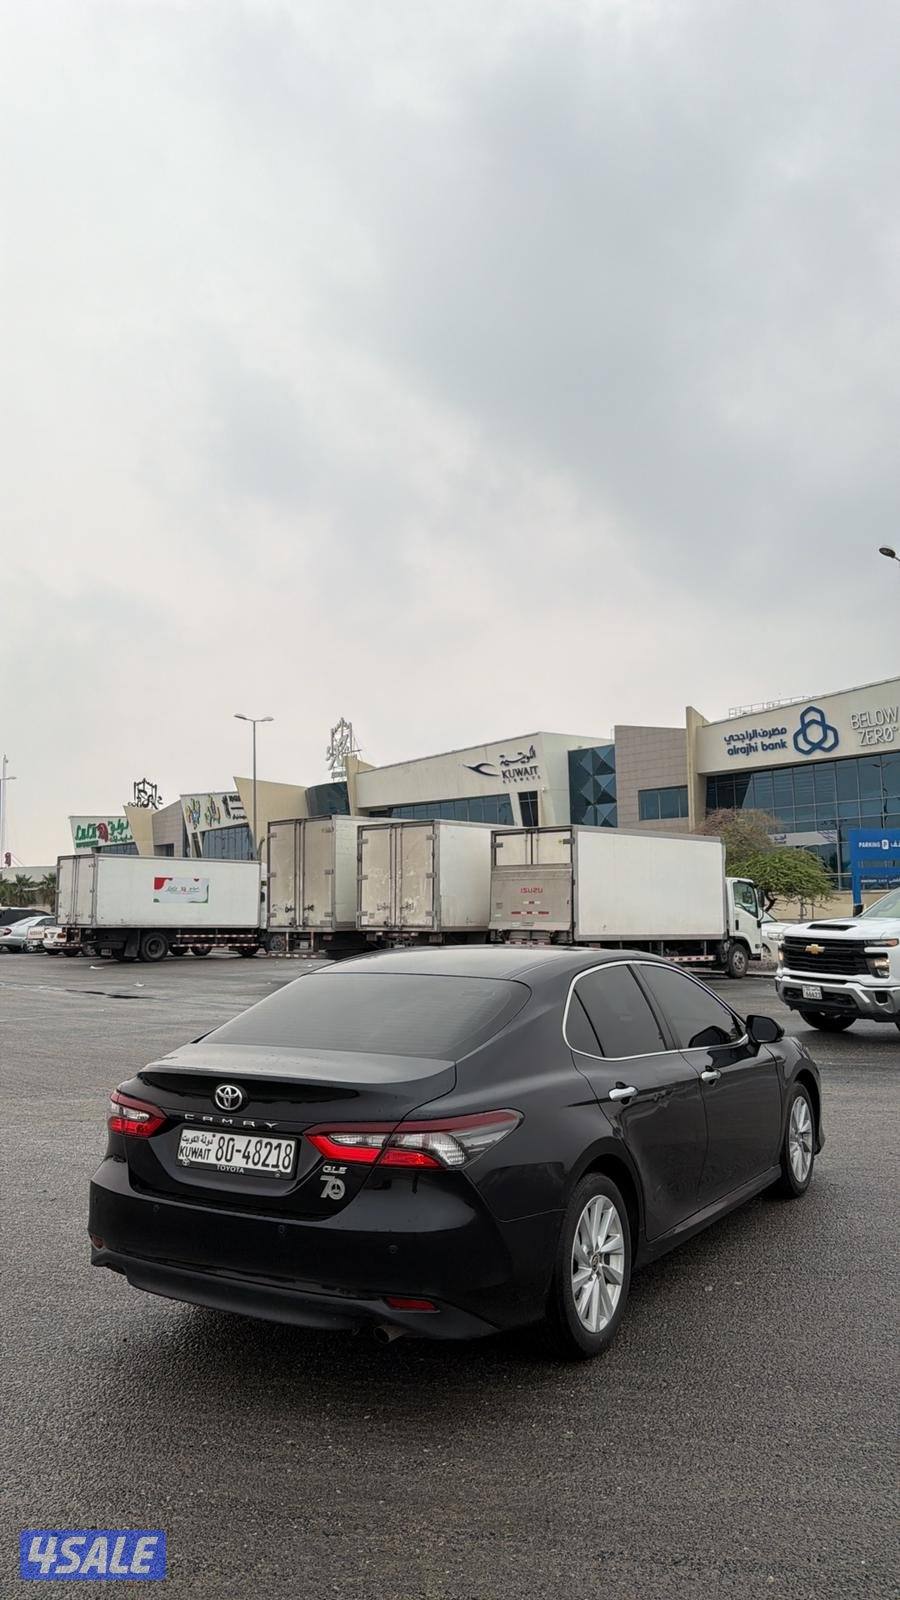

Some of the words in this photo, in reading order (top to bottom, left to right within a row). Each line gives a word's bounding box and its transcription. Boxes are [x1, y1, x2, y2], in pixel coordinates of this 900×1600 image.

[850, 706, 899, 730] BELOW
[727, 742, 758, 757] alrajhi
[761, 738, 788, 752] bank
[501, 765, 539, 779] KUWAIT
[184, 1113, 279, 1129] CAMRY
[178, 1145, 212, 1161] KUWAIT
[215, 1136, 293, 1170] 80-48218
[216, 1164, 245, 1174] TOYOTA
[322, 1165, 348, 1175] GLE
